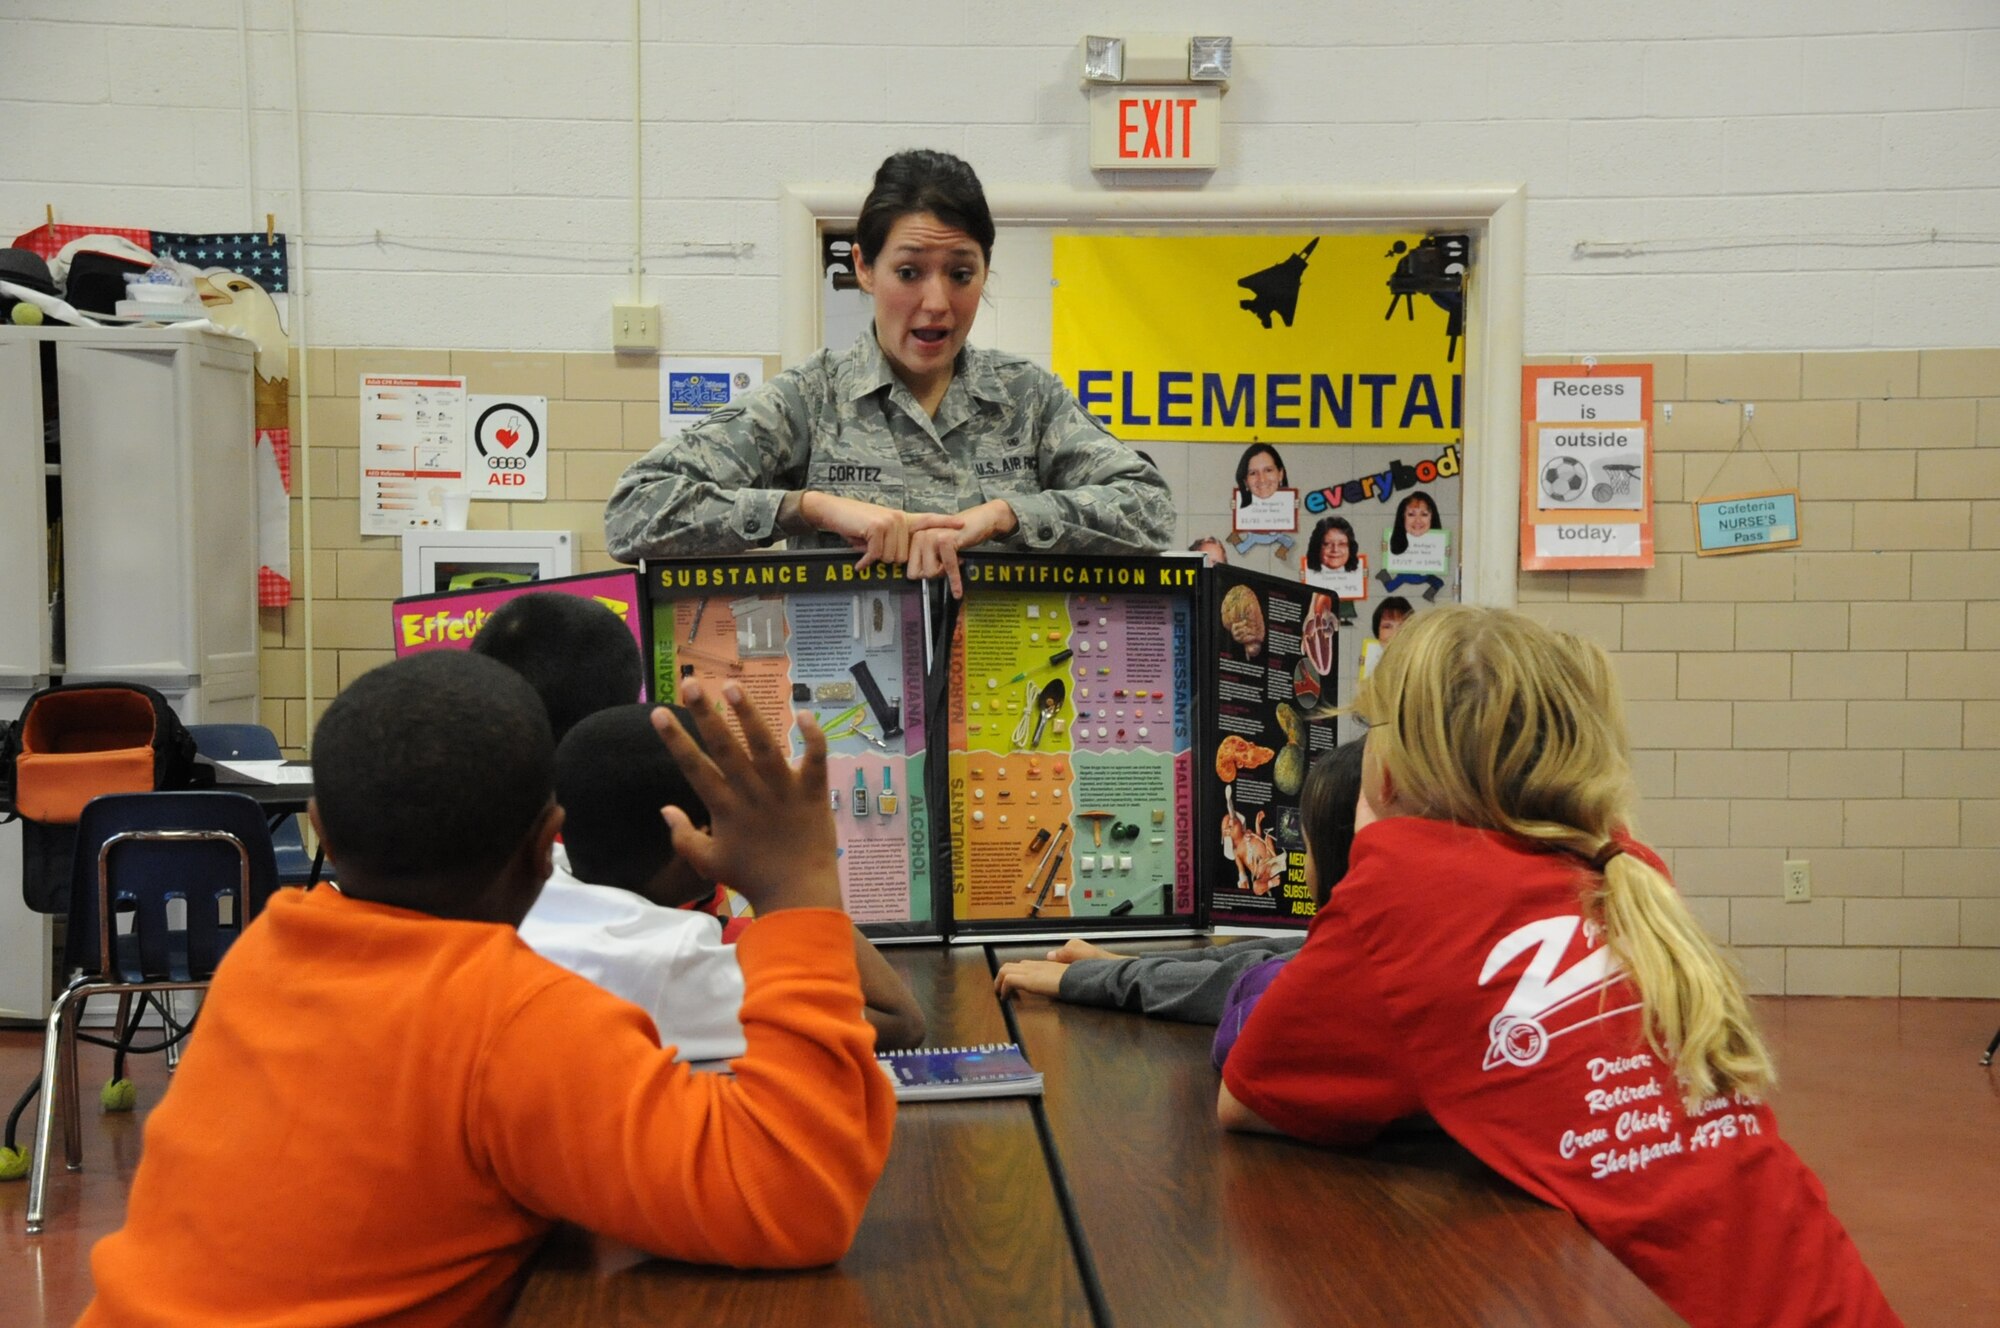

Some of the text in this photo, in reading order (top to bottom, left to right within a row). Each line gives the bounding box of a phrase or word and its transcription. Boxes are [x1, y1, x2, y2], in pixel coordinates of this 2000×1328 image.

[1119, 99, 1197, 158] EXIT
[1553, 381, 1624, 396] Recess
[1581, 404, 1596, 419] is
[1555, 432, 1628, 447] outside
[829, 465, 881, 482] CORTEZ
[975, 461, 998, 475] U.S.
[1002, 457, 1021, 472] AIR
[488, 473, 526, 486] AED
[1304, 443, 1461, 514] everybod
[1718, 501, 1775, 515] Cafeteria
[1557, 525, 1617, 541] today.
[1719, 514, 1776, 529] NURSE'S
[1734, 532, 1763, 542] Pass
[661, 563, 903, 588] SUBSTANCE ABUSE
[968, 565, 1196, 586] DENTIFICATION KIT
[905, 620, 922, 729] MARIJUANA
[1173, 611, 1188, 738] DEPRESSANTS
[910, 794, 926, 881] ALCOHOL
[951, 777, 965, 895] STIMULANTS
[1175, 758, 1190, 909] HALLUCINOGENS
[1292, 901, 1317, 916] ABUSE
[1586, 1054, 1652, 1082] Driver:
[1585, 1077, 1662, 1115] Retired:
[1559, 1128, 1609, 1159] Crew
[1615, 1105, 1672, 1141] Chief:
[1590, 1132, 1683, 1179] Sheppard
[1690, 1114, 1738, 1151] AFB
